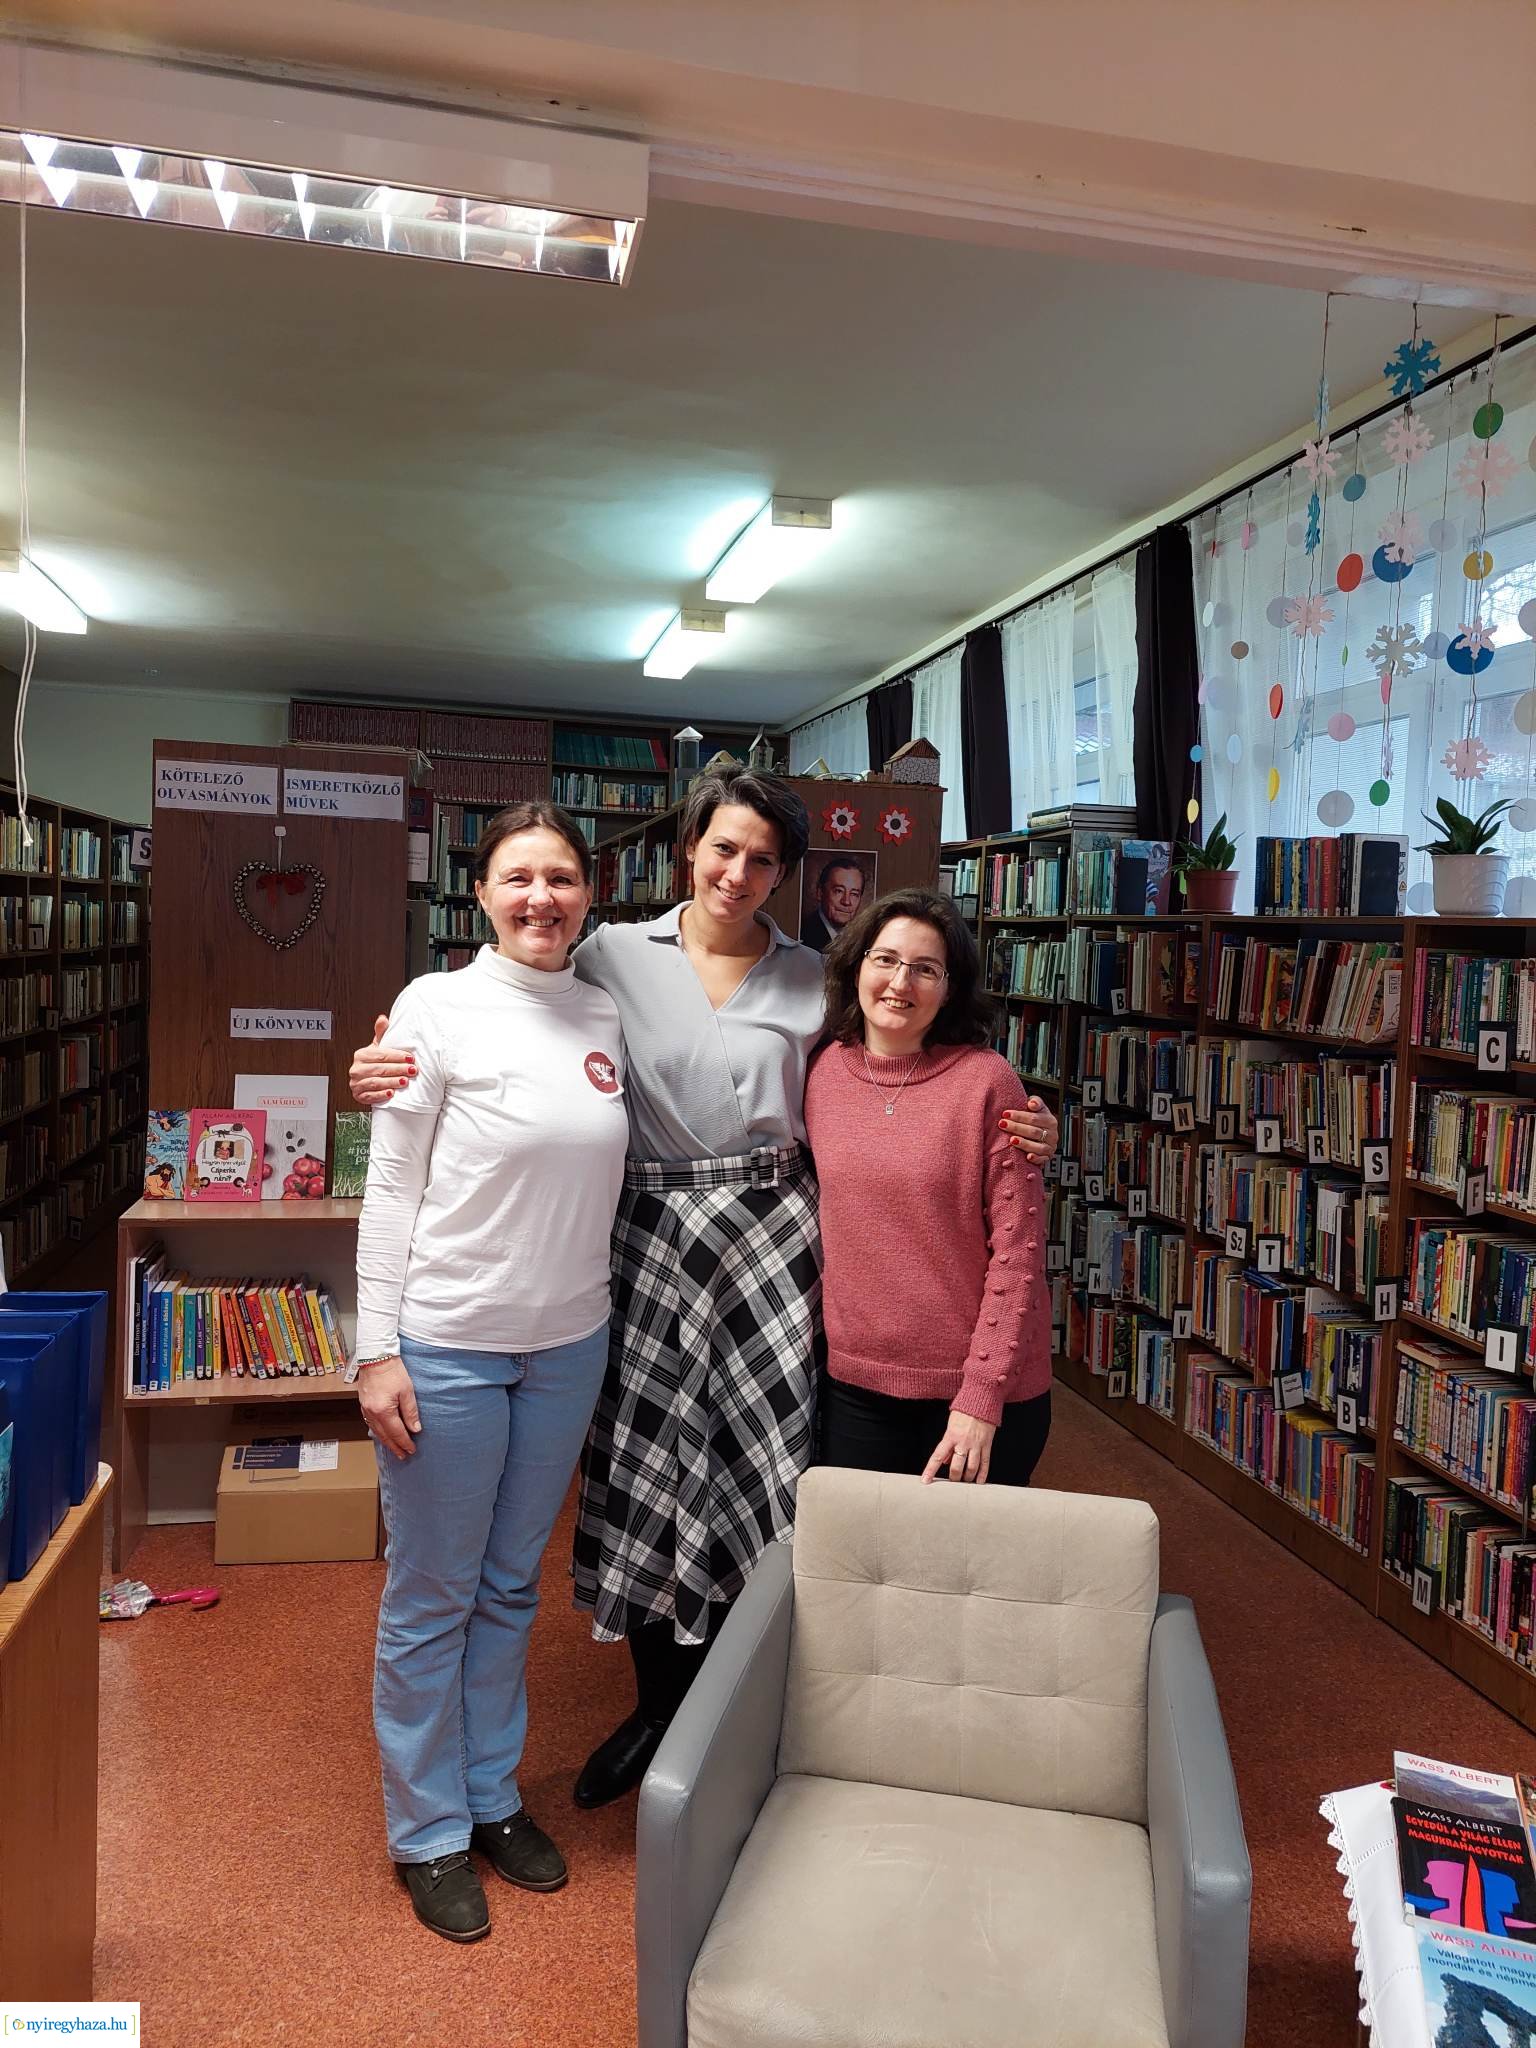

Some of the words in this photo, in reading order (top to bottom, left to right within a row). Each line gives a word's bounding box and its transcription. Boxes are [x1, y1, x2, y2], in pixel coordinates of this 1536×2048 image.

[161, 768, 244, 785] KÖTELEZŐ
[157, 787, 272, 805] OLVASMÁNYOK
[286, 778, 401, 796] ISMERETKÖZLŐ
[286, 795, 339, 810] MŰVEK
[140, 838, 152, 859] S
[1116, 992, 1125, 1009] B
[232, 1014, 249, 1030] ÚJ
[255, 1016, 327, 1031] KÖNYVEK
[1486, 1036, 1500, 1064] C
[1088, 1085, 1097, 1101] C
[1157, 1100, 1168, 1115] D
[1178, 1108, 1190, 1126] N
[1221, 1114, 1229, 1135] O
[1264, 1126, 1272, 1146] P
[1315, 1136, 1324, 1156] R
[1371, 1151, 1384, 1175] S
[1066, 1166, 1074, 1182] F
[1089, 1180, 1099, 1197] G
[1472, 1182, 1480, 1207] F
[1133, 1194, 1142, 1212] H
[1230, 1232, 1244, 1252] Sz
[1265, 1244, 1275, 1266] T
[1077, 1260, 1085, 1278] J
[1380, 1292, 1390, 1315] H
[1179, 1315, 1187, 1336] V
[1499, 1336, 1505, 1362] I
[1112, 1376, 1122, 1393] M
[1342, 1400, 1351, 1424] B
[1417, 1580, 1429, 1605] M
[1408, 1757, 1445, 1774] WASS
[1449, 1768, 1501, 1787] ALBERT
[1417, 1807, 1452, 1824] WASS
[1455, 1818, 1503, 1835] ALBERT
[1405, 1814, 1449, 1834] EGYEDÜL
[1450, 1827, 1459, 1837] A
[1492, 1836, 1522, 1850] ELLEN
[1408, 1828, 1525, 1865] MAGUKRAHAGYOTTAK
[1430, 1930, 1475, 1948] WASS
[1427, 1956, 1475, 1973] mondák
[1479, 1967, 1493, 1978] és
[1437, 1948, 1497, 1970] Válogatott
